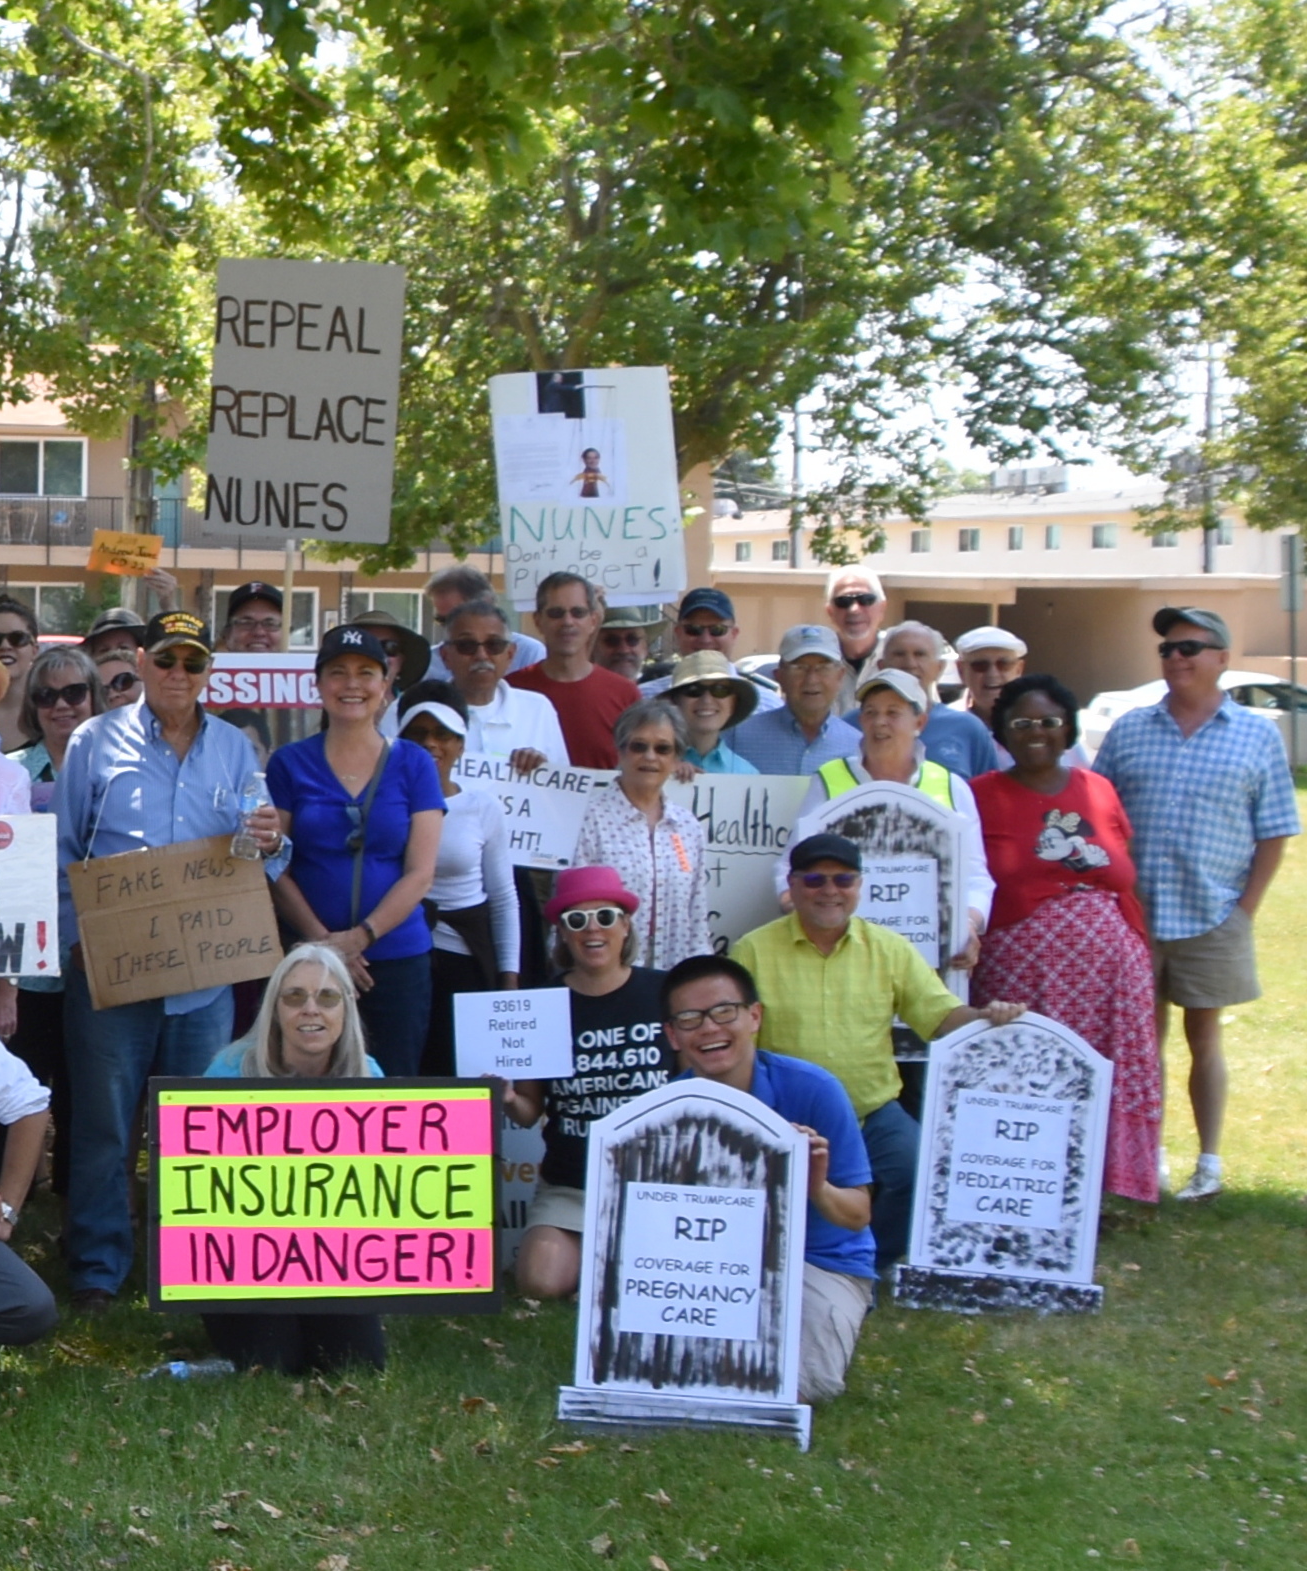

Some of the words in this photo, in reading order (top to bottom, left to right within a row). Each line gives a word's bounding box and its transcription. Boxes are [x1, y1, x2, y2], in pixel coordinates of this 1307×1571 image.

[216, 297, 381, 355] REPEAL
[209, 384, 387, 446] REPLACE
[204, 475, 349, 533] NUNES
[509, 506, 679, 543] NUNES:
[506, 543, 558, 563] Don't
[578, 541, 602, 561] be
[636, 546, 649, 559] a
[517, 798, 531, 817] A
[96, 867, 164, 904] FAKE
[183, 856, 236, 884] NEWS
[875, 864, 930, 874] TRUMPCARE
[870, 883, 910, 902] RIP
[150, 916, 159, 939] I
[178, 908, 234, 933] PAID
[906, 915, 930, 926] FOR
[109, 948, 185, 985] THESE
[198, 935, 273, 962] PEOPLE
[492, 999, 531, 1012] 93619
[488, 1018, 537, 1031] Retired
[501, 1037, 525, 1049] Not
[578, 1026, 626, 1049] ONE
[630, 1023, 662, 1042] OF
[495, 1055, 533, 1067] Hired
[551, 1070, 670, 1097] AMERICANS
[965, 1097, 999, 1107] UNDER
[1004, 1100, 1064, 1114] TRUMPCARE
[182, 1103, 449, 1155] EMPLOYER
[995, 1119, 1040, 1141] RIP
[960, 1153, 1026, 1169] COVERAGE
[1031, 1159, 1057, 1171] FOR
[171, 1162, 477, 1220] INSURANCE
[956, 1171, 1057, 1194] PEDIATRIC
[637, 1191, 678, 1202] UNDER
[684, 1193, 756, 1208] TRUMPCARE
[976, 1195, 1033, 1217] CARE
[674, 1216, 728, 1242] RIP
[188, 1238, 240, 1282] IN
[250, 1231, 477, 1287] DANGER!
[634, 1257, 714, 1274] COVERAGE
[719, 1262, 750, 1275] FOR
[625, 1278, 757, 1304] PREGNANCY
[661, 1306, 718, 1326] CARE
